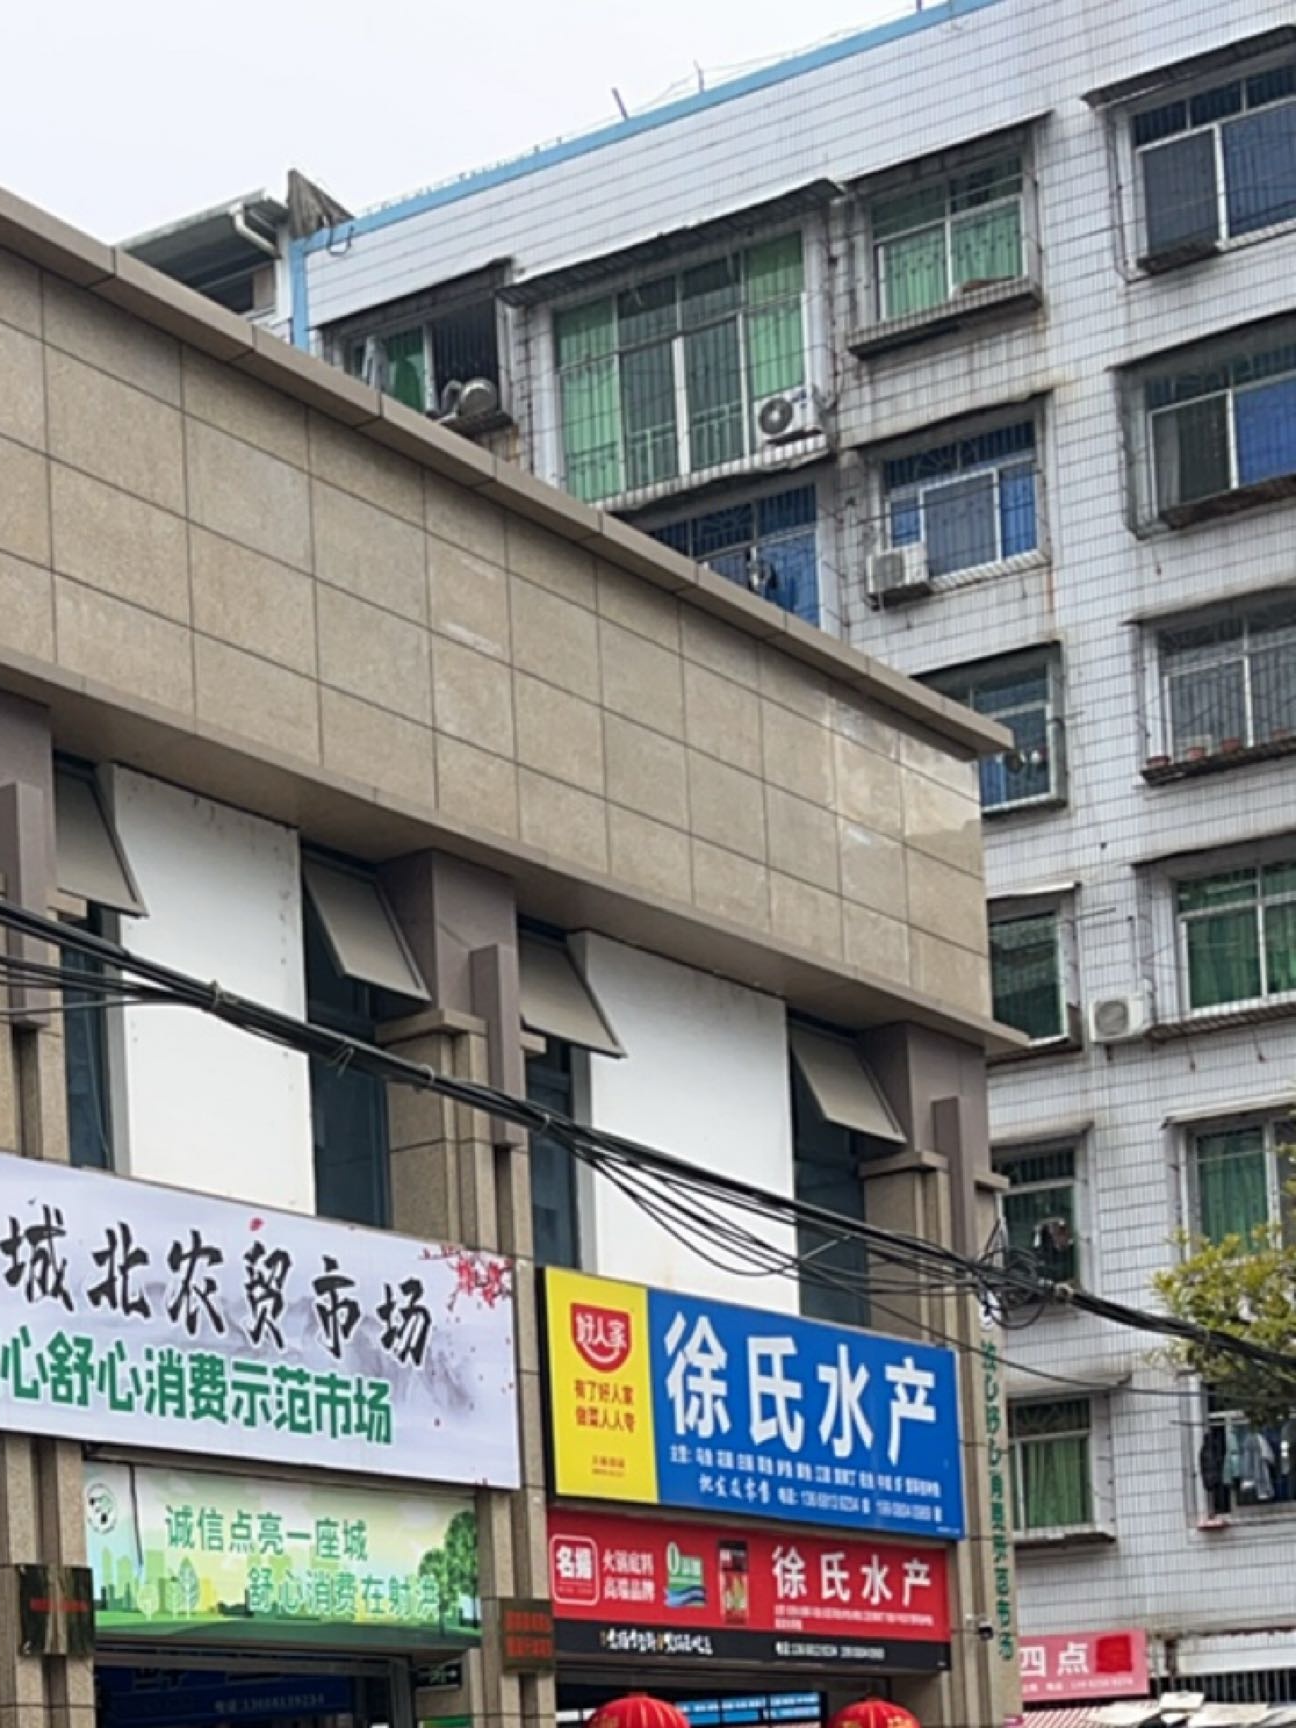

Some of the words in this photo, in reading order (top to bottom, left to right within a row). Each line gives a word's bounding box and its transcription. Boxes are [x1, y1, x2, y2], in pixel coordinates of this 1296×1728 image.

[663, 1310, 938, 1466] 徐氏水产
[163, 1503, 369, 1563] 诚信点亮一座城
[771, 1544, 932, 1607] 徐氏水产
